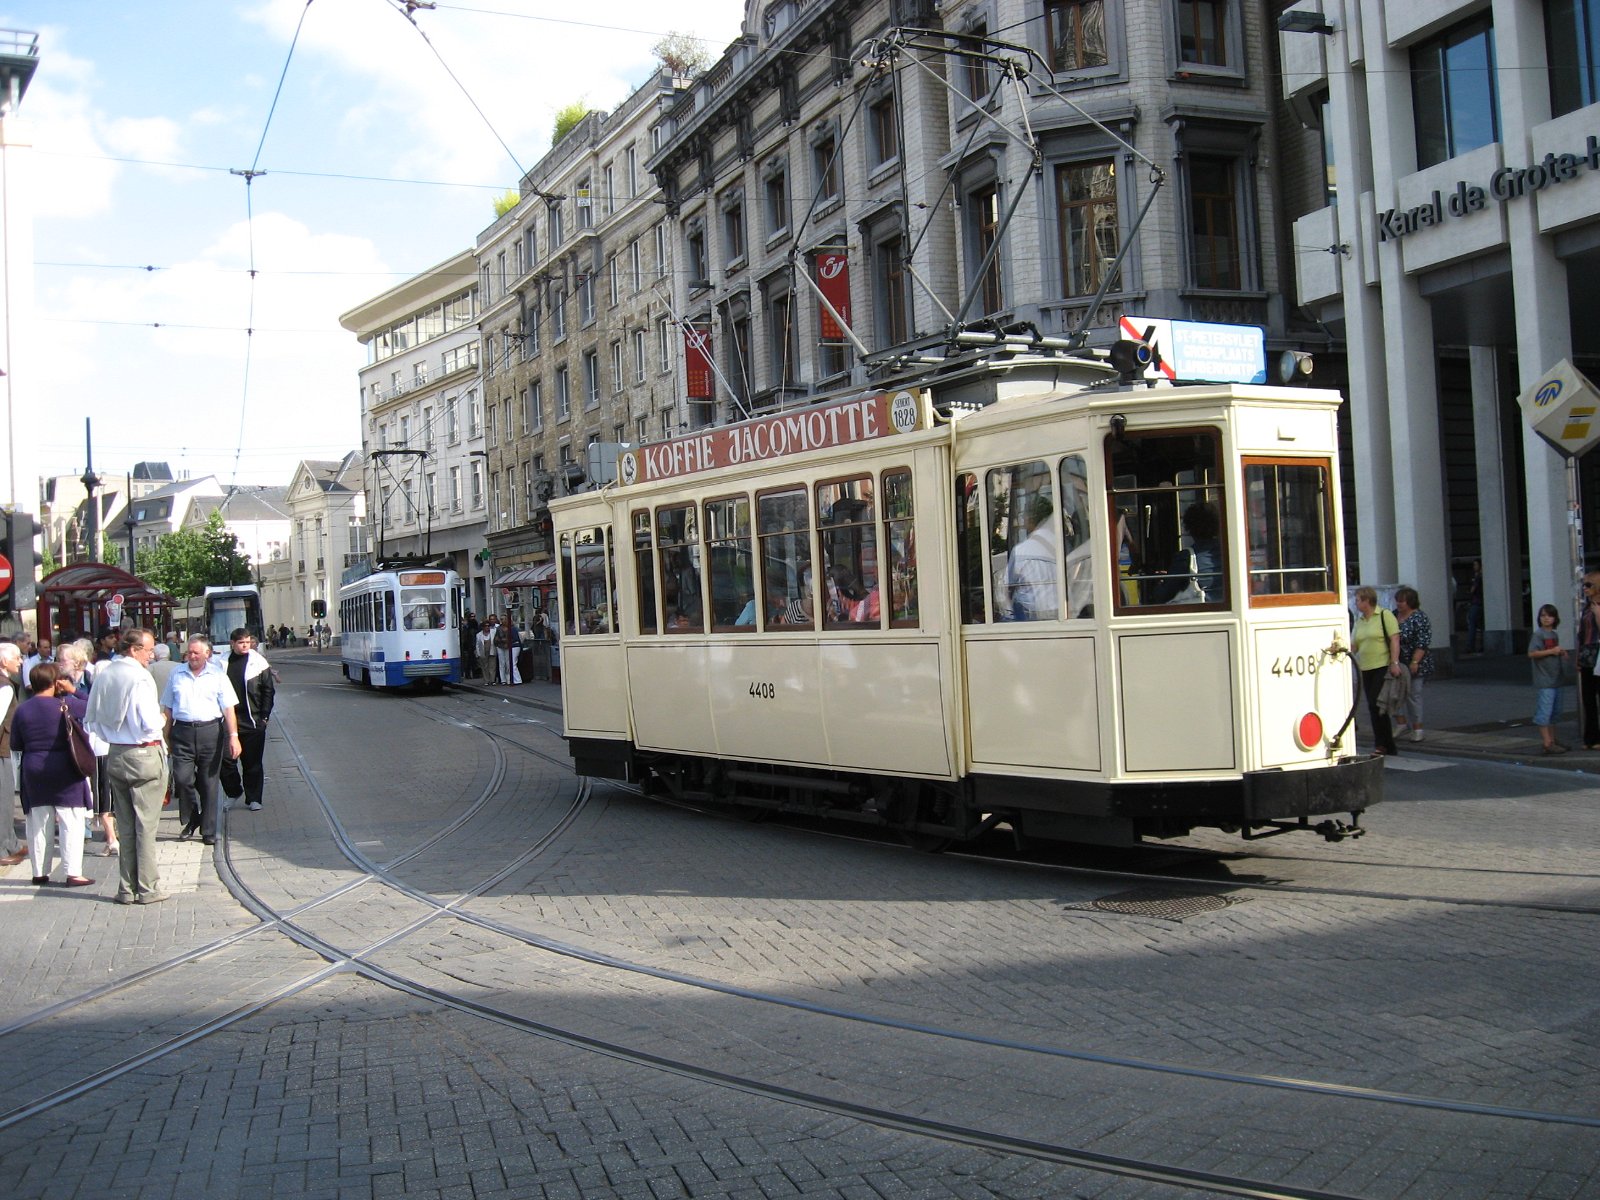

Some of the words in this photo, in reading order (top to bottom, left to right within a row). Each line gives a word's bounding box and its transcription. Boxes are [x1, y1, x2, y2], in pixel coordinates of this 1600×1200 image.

[1376, 190, 1442, 242] Karel
[1448, 181, 1485, 217] de
[894, 407, 916, 428] 1828
[646, 435, 715, 480] KOFFIE
[729, 400, 879, 464] JACOMOTTE
[1271, 655, 1317, 678] 4408
[749, 682, 775, 699] 4408
